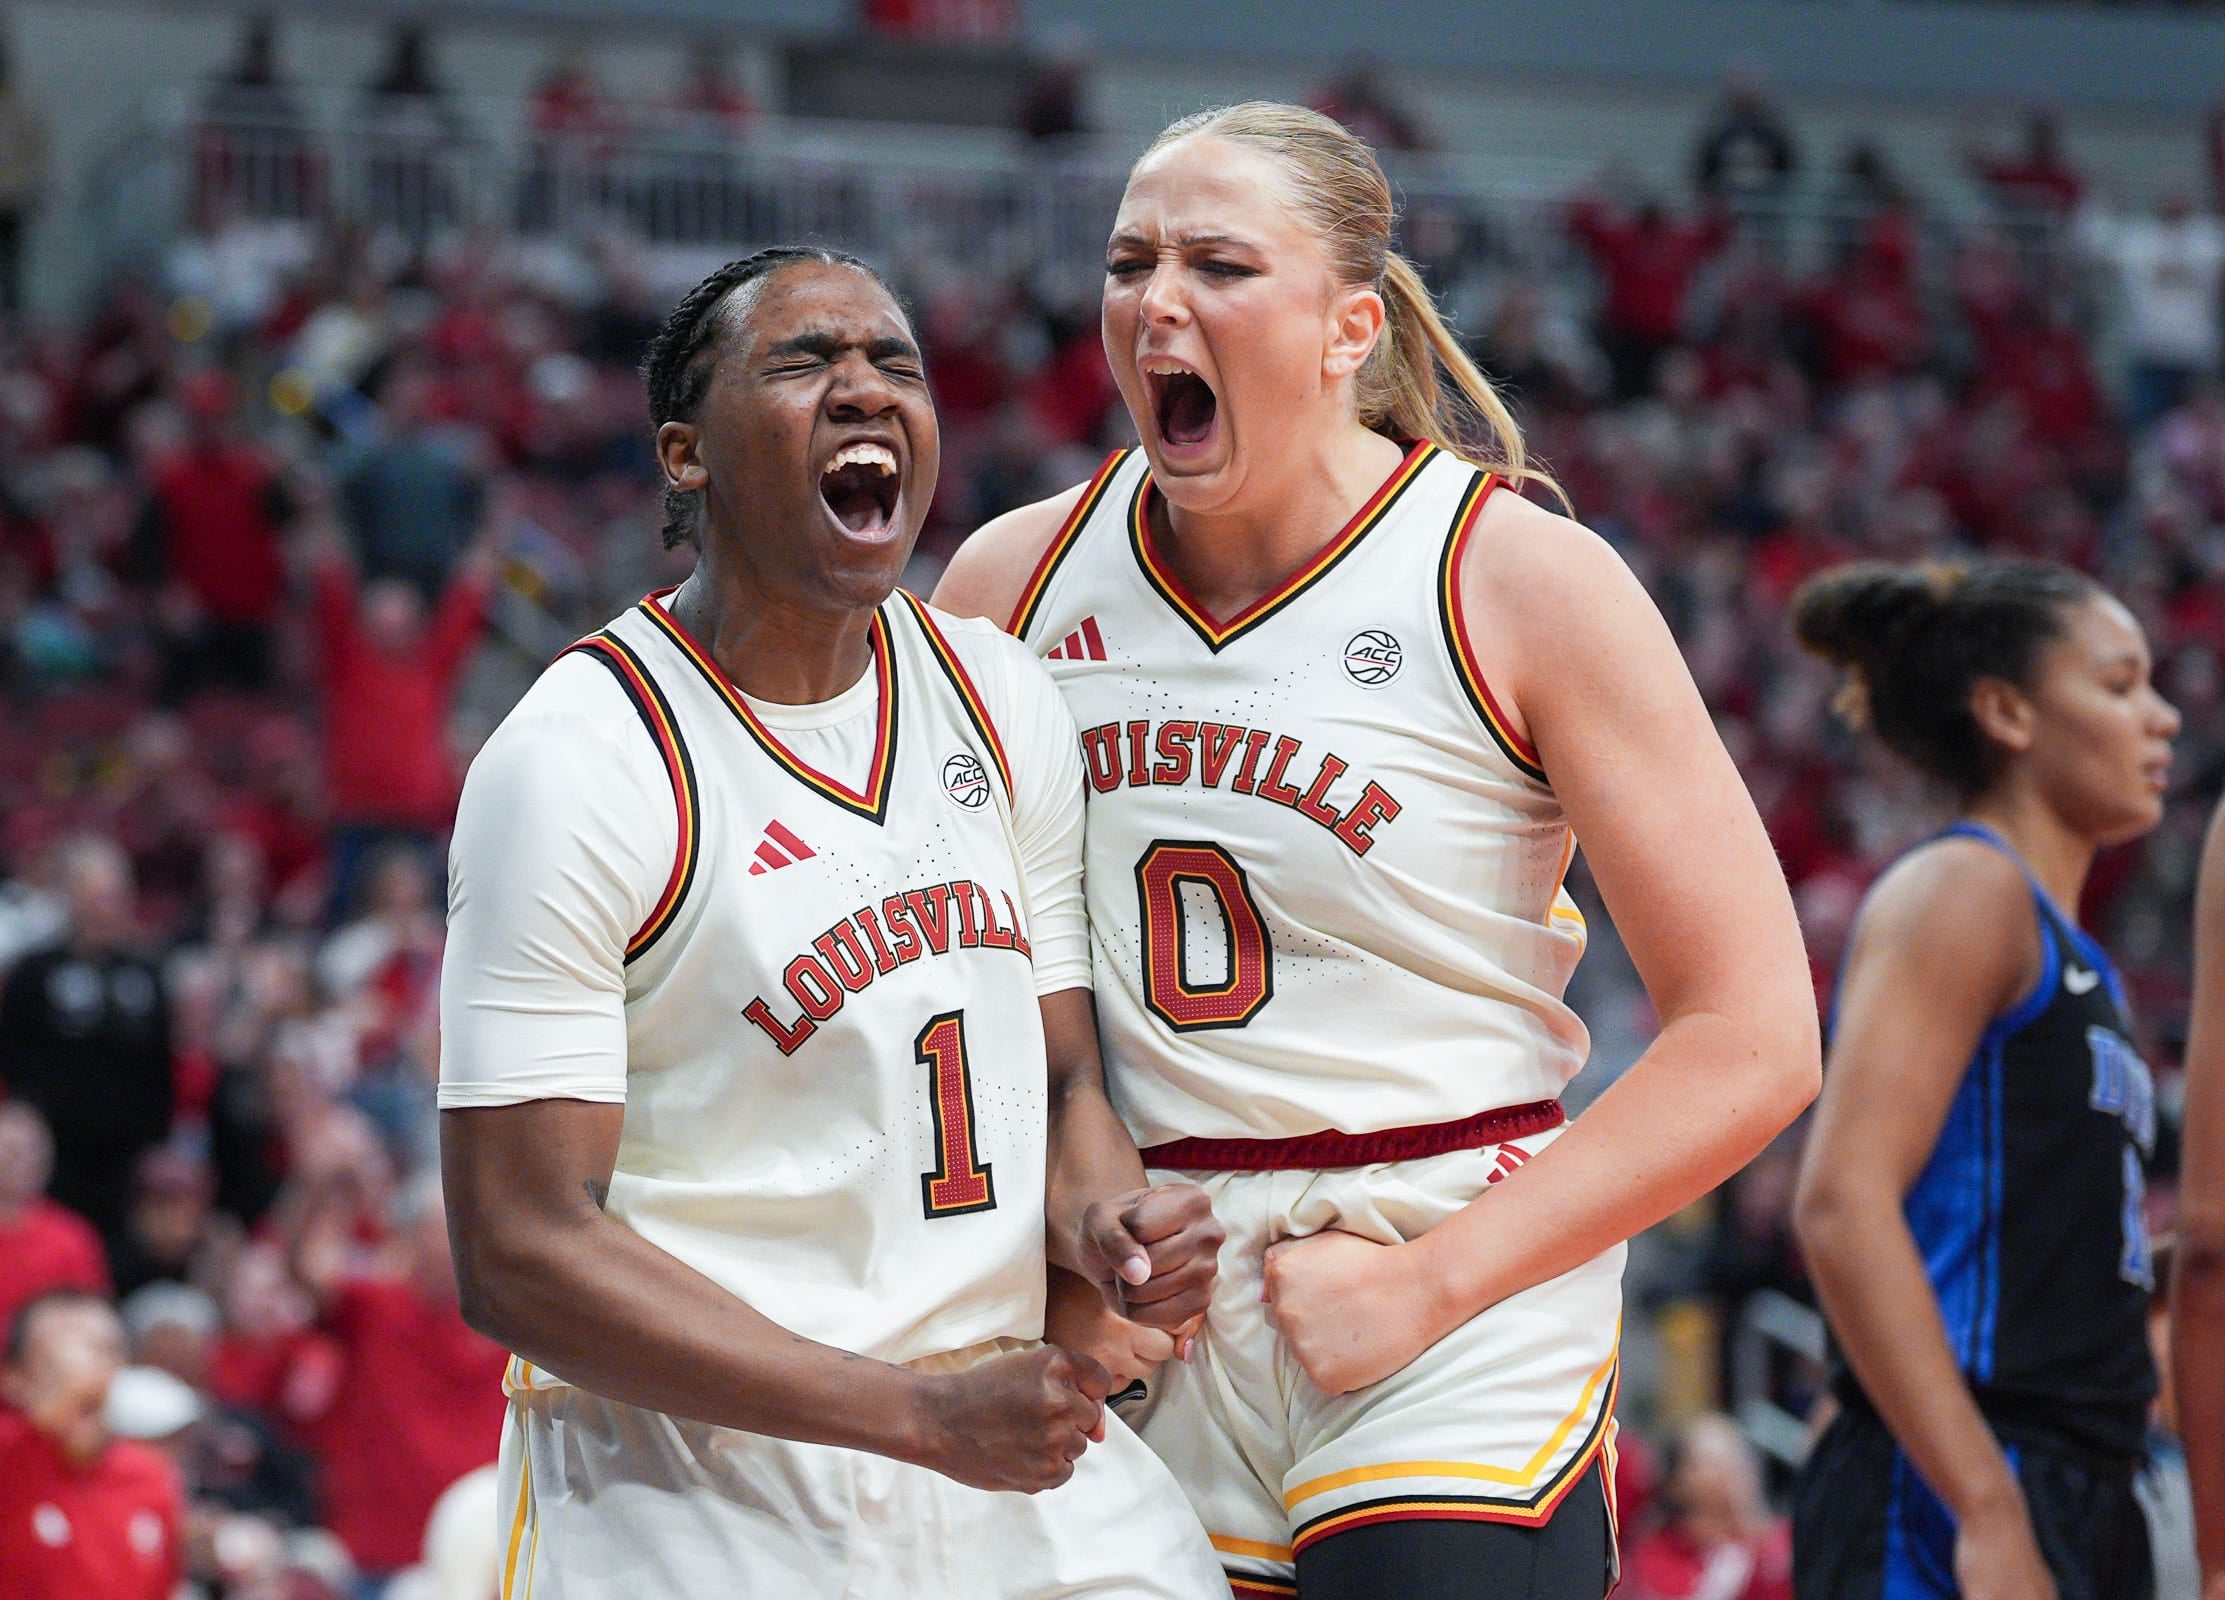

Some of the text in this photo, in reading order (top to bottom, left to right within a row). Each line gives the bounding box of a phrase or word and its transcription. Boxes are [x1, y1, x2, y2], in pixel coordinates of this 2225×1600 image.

[1351, 646, 1402, 663] ACC
[951, 766, 984, 787] ACC
[1081, 719, 1403, 858] UISVILLE
[1134, 839, 1274, 1033] 0
[914, 1008, 997, 1220] 1
